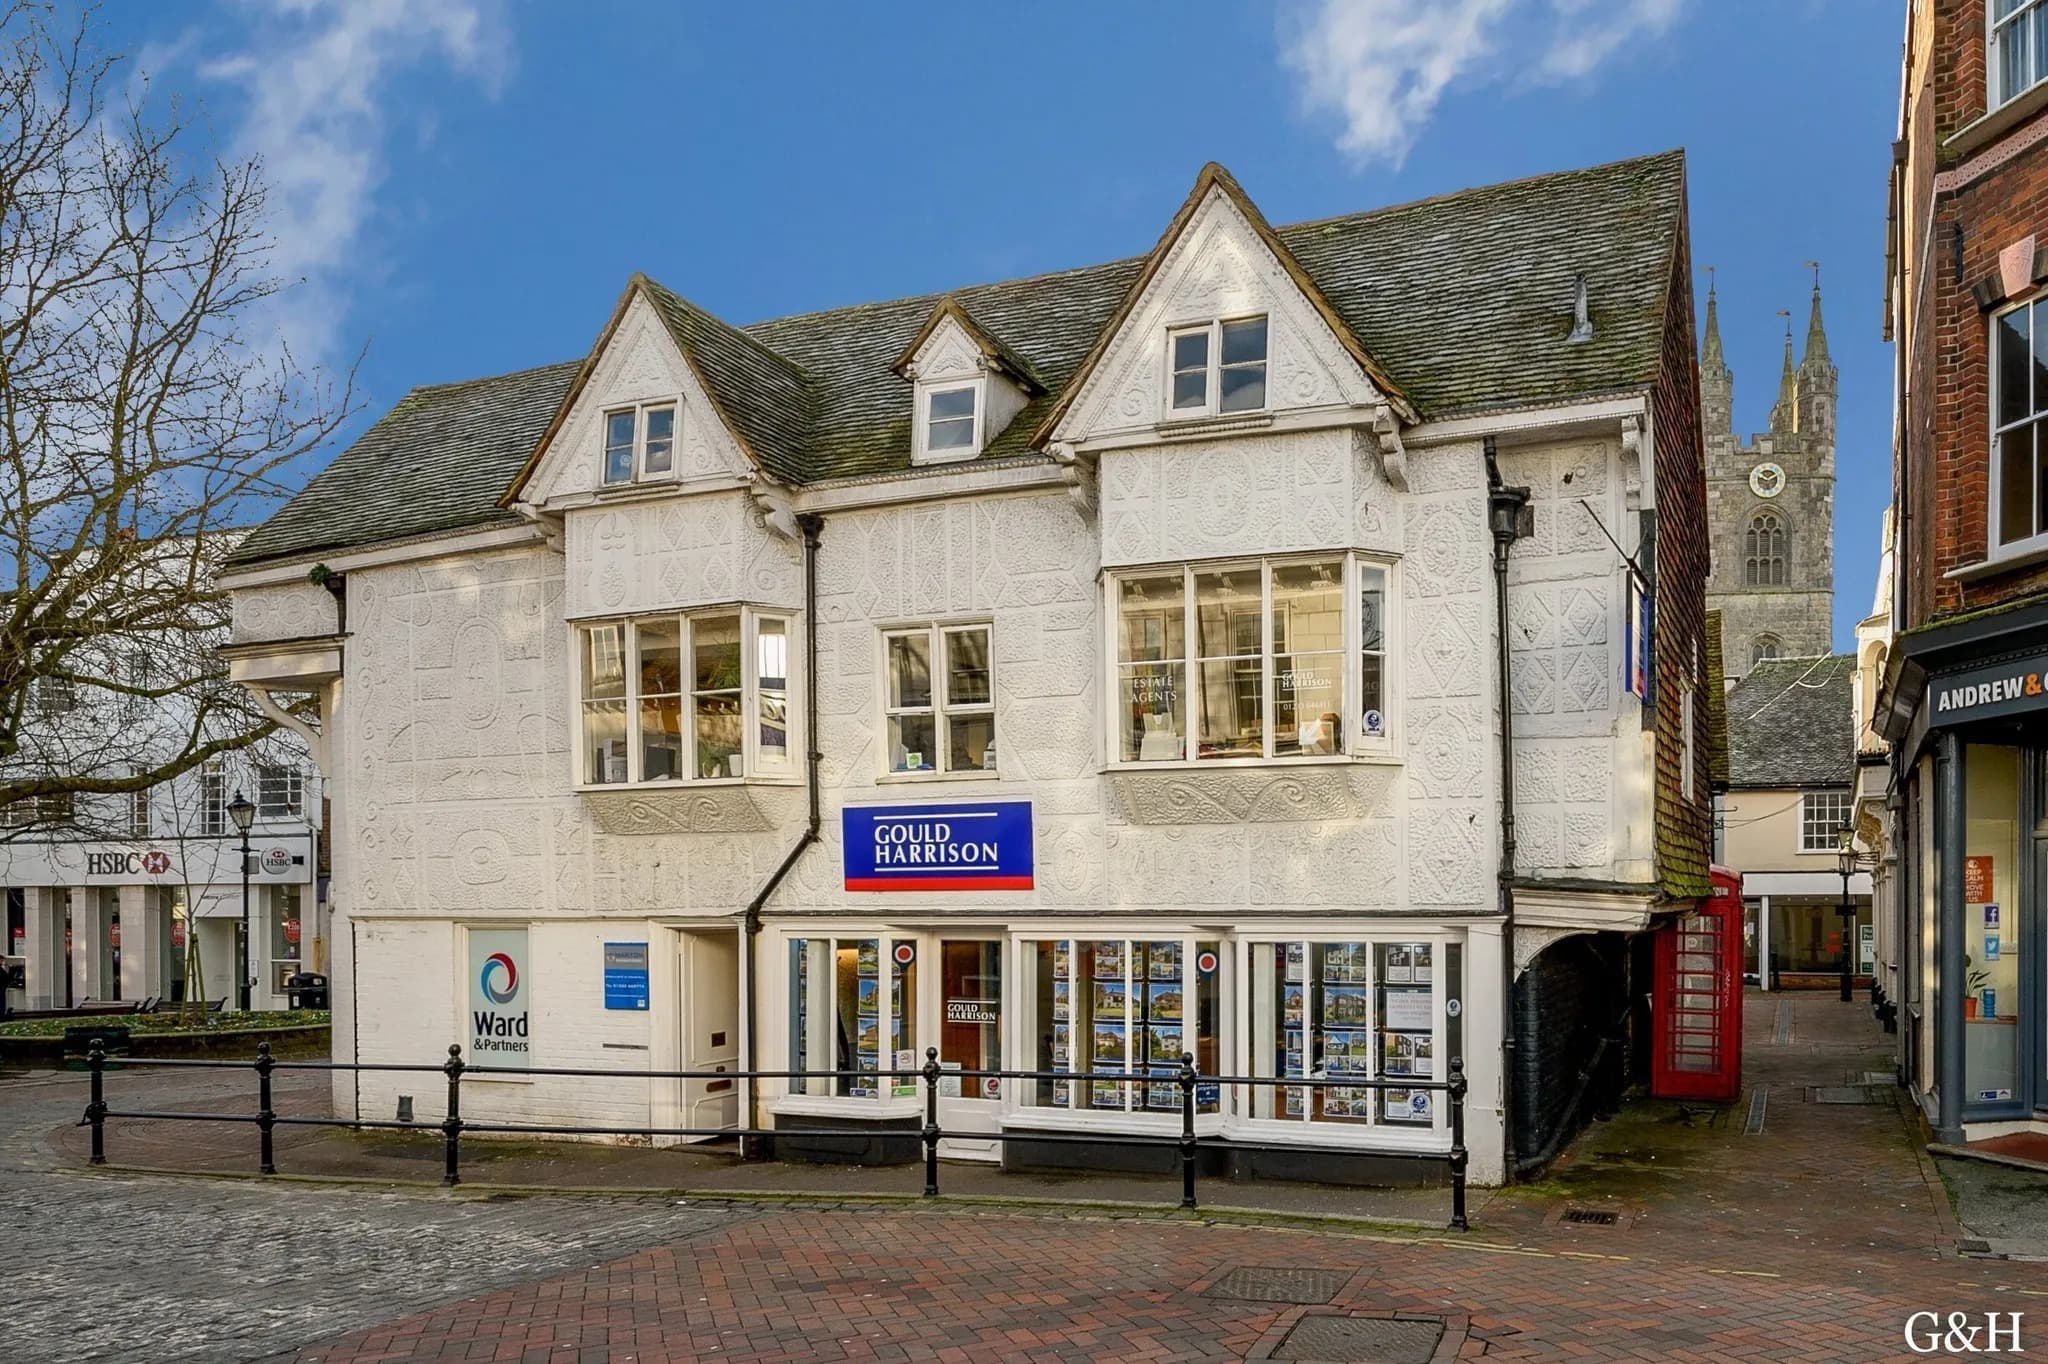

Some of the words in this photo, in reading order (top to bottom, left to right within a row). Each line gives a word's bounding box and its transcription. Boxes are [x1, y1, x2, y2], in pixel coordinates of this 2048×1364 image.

[1134, 676, 1173, 689] ESTATE
[1282, 671, 1314, 681] GOULD
[1282, 679, 1332, 689] HARRISON
[1131, 690, 1177, 703] AGENTS
[874, 823, 951, 844] GOULD
[875, 842, 998, 864] HARRISON
[87, 853, 140, 875] HSBC
[266, 858, 291, 866] HSBC
[947, 1003, 978, 1013] GOULD
[947, 1011, 996, 1021] HARRISON
[473, 1011, 529, 1037] Ward
[473, 1038, 529, 1052] &Partners
